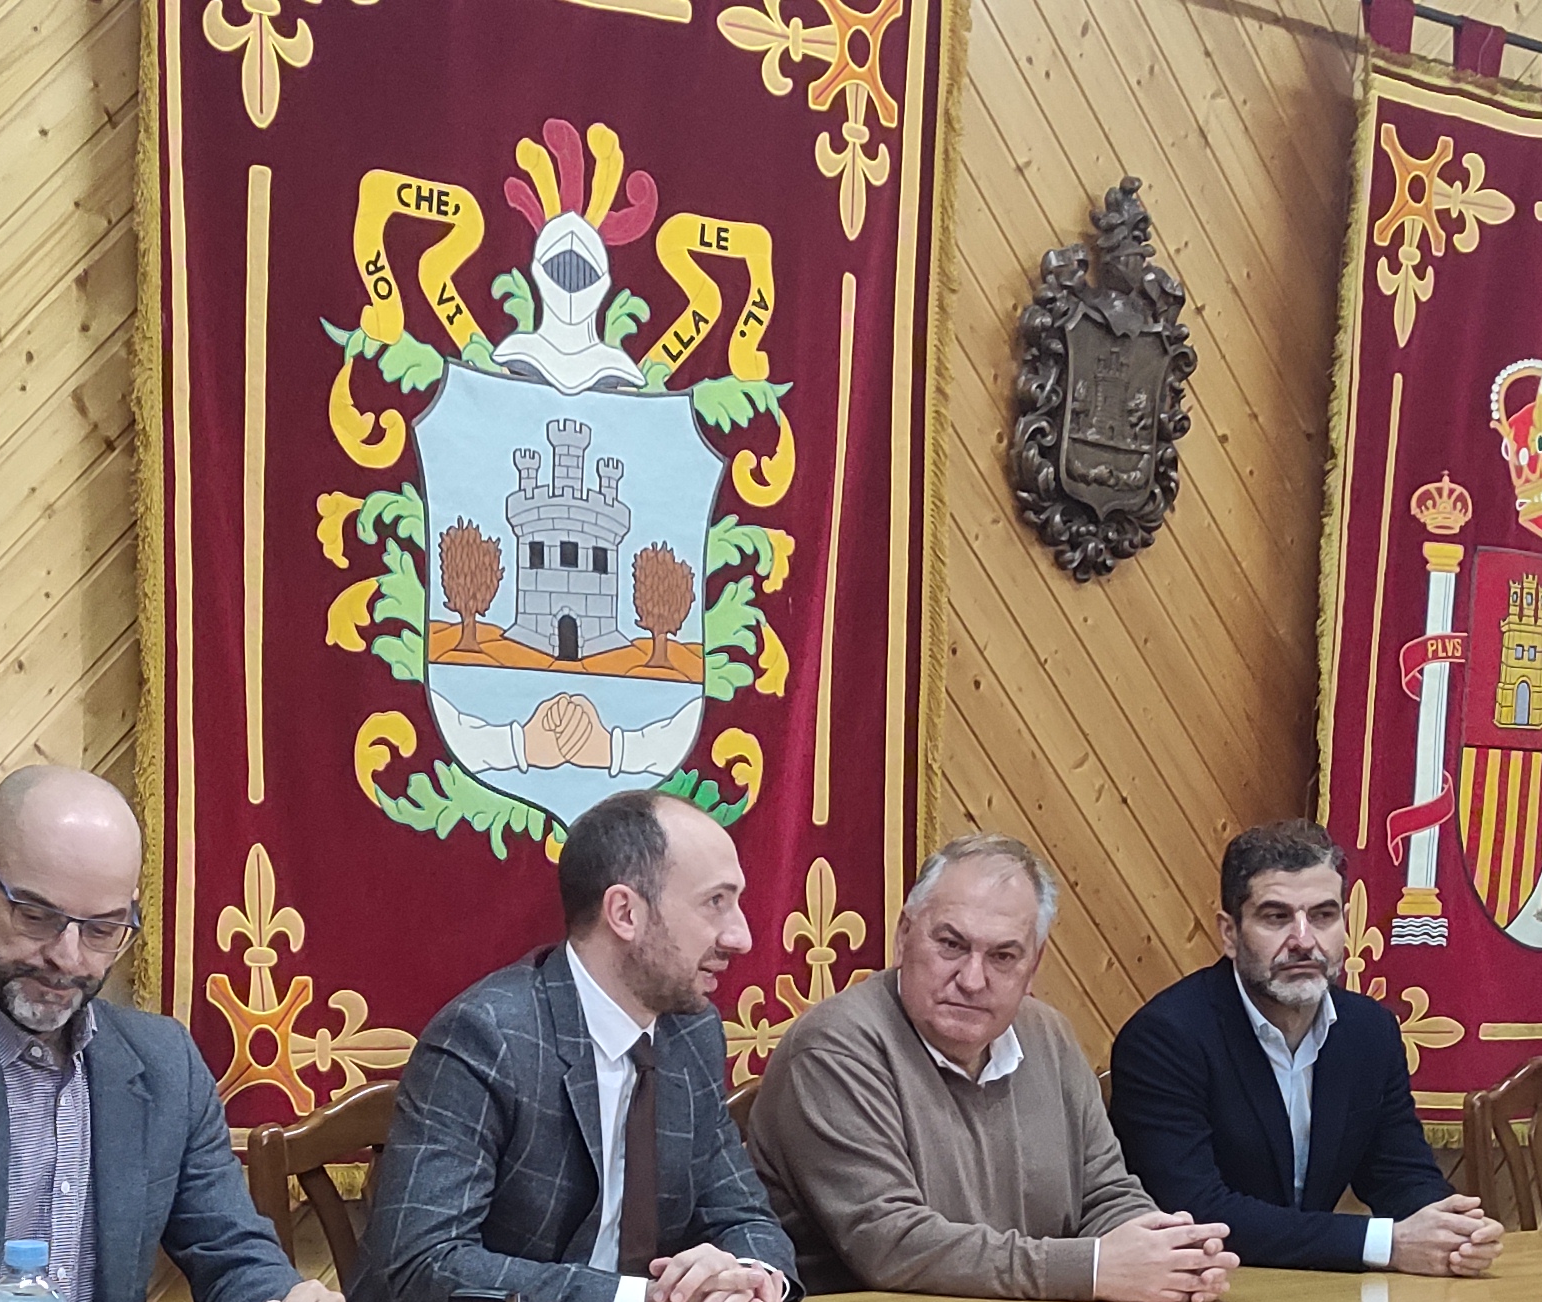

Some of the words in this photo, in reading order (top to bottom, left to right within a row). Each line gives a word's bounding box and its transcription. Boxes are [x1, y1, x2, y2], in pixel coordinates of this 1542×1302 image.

[365, 249, 393, 300] OR
[397, 183, 460, 216] CHE,
[437, 282, 463, 325] VI
[661, 310, 709, 363] LLA
[699, 223, 729, 251] LE
[739, 287, 769, 338] AL.
[1427, 638, 1462, 659] PLVS
